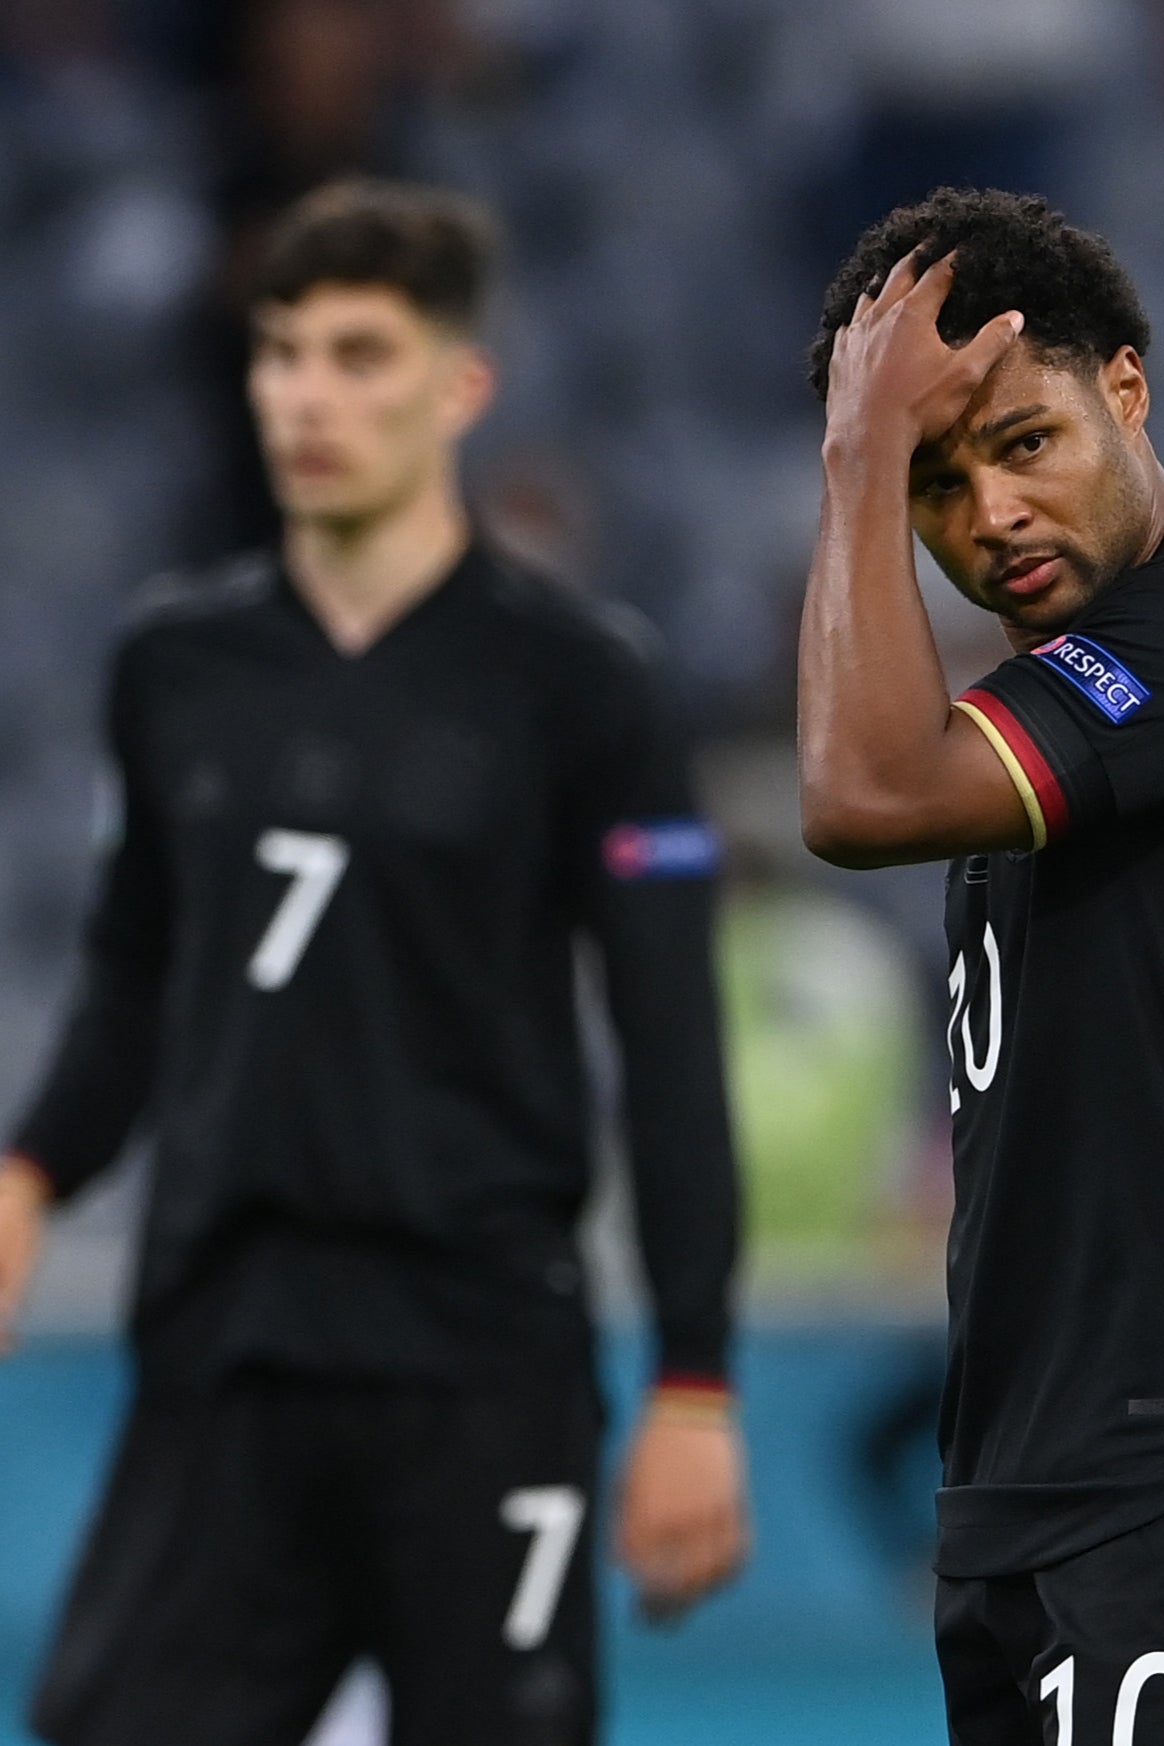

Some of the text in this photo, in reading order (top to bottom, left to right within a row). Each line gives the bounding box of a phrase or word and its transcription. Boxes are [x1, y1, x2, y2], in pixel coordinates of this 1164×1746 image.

[1053, 642, 1141, 712] RESPECT
[250, 829, 347, 990] 7
[947, 921, 1002, 1115] 10
[500, 1486, 585, 1650] 7
